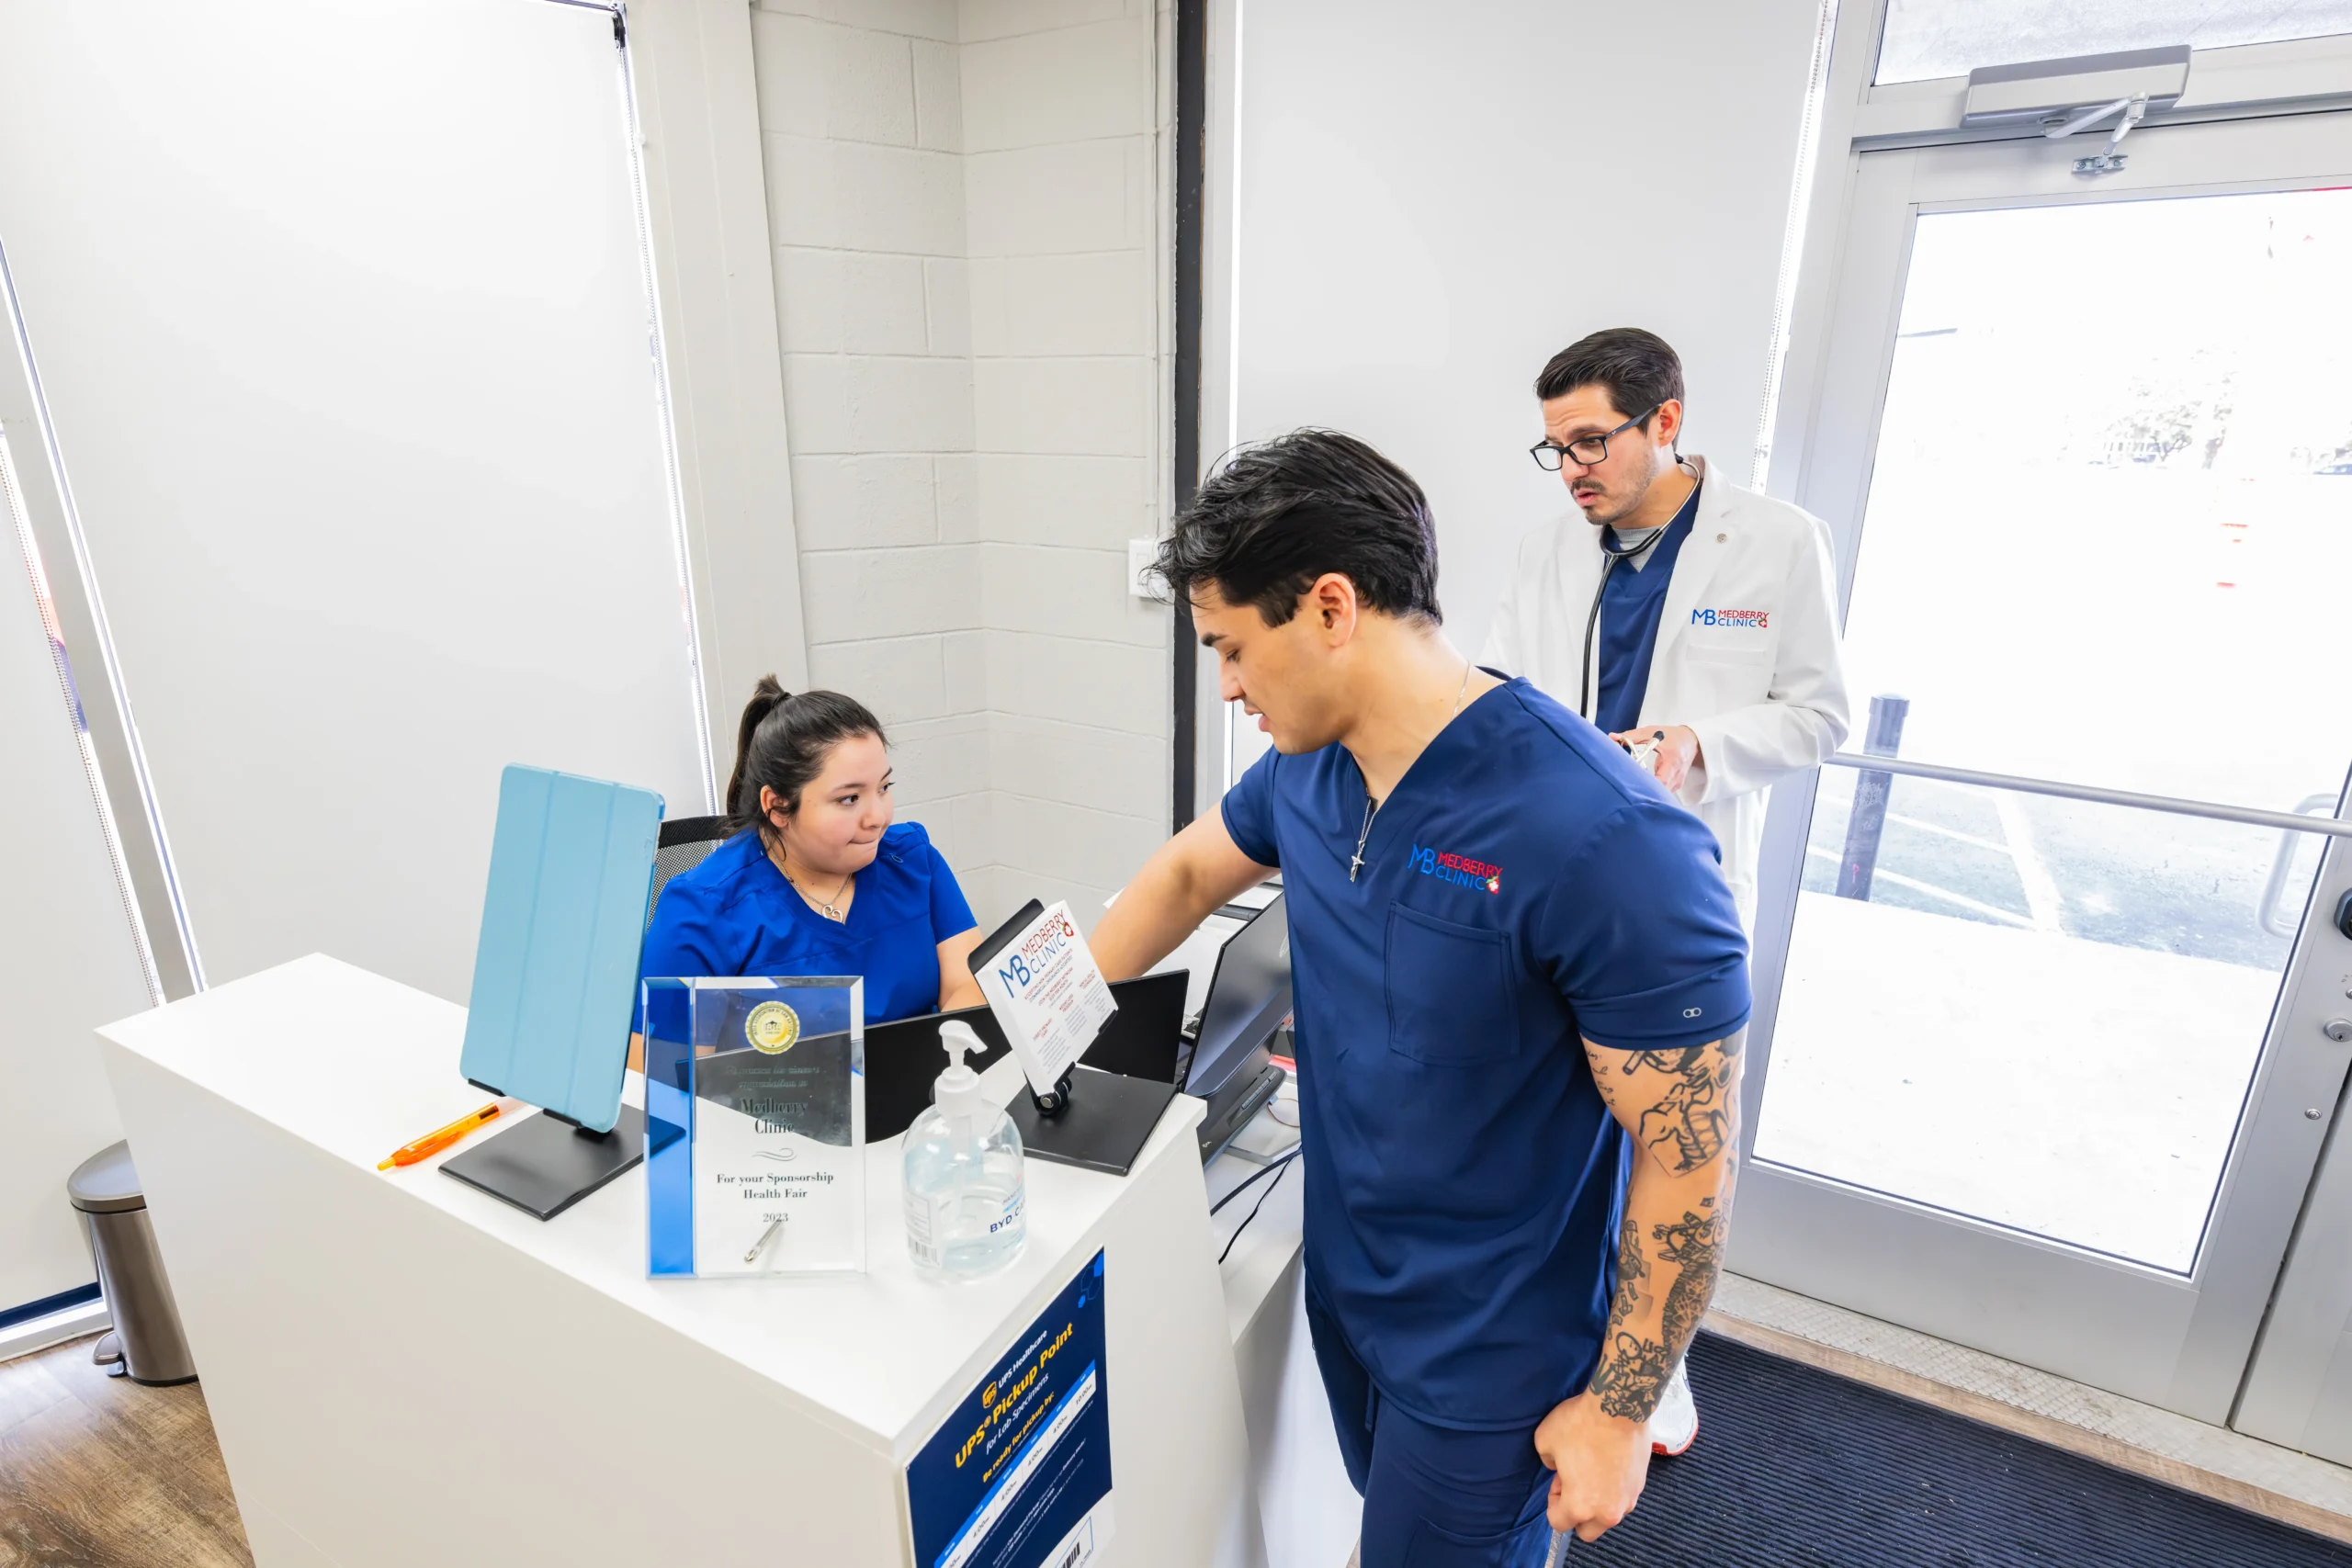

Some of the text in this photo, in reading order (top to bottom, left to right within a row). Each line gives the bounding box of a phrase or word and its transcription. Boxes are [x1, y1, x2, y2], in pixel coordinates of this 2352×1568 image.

[1691, 609, 1715, 626] MB
[1717, 618, 1757, 627] CLINIC
[1718, 609, 1770, 619] MEDBERRY
[1408, 843, 1435, 874] MB
[1438, 852, 1503, 878] MEDBERRY
[1435, 865, 1487, 891] CLINIC
[1021, 909, 1066, 961] MEDBERRY
[1030, 931, 1066, 974] CLINIC
[999, 954, 1031, 998] MB
[741, 1098, 808, 1116] Medberry
[754, 1118, 795, 1134] Clinic
[717, 1171, 834, 1187] For your Sponsorship
[743, 1188, 808, 1200] Health Fair
[763, 1213, 789, 1224] 2023
[990, 1214, 1012, 1233] BYD
[999, 1368, 1012, 1389] UPS
[1013, 1330, 1047, 1372] Healthcare
[993, 1366, 1037, 1424] Pickup
[1040, 1323, 1072, 1369] Point
[986, 1436, 997, 1455] for
[998, 1418, 1012, 1438] Lab
[1012, 1373, 1049, 1421] Specimens
[982, 1469, 992, 1483] Be
[992, 1443, 1012, 1470] ready
[1012, 1435, 1023, 1450] for
[1023, 1404, 1045, 1436] pickup
[1045, 1391, 1055, 1406] by:
